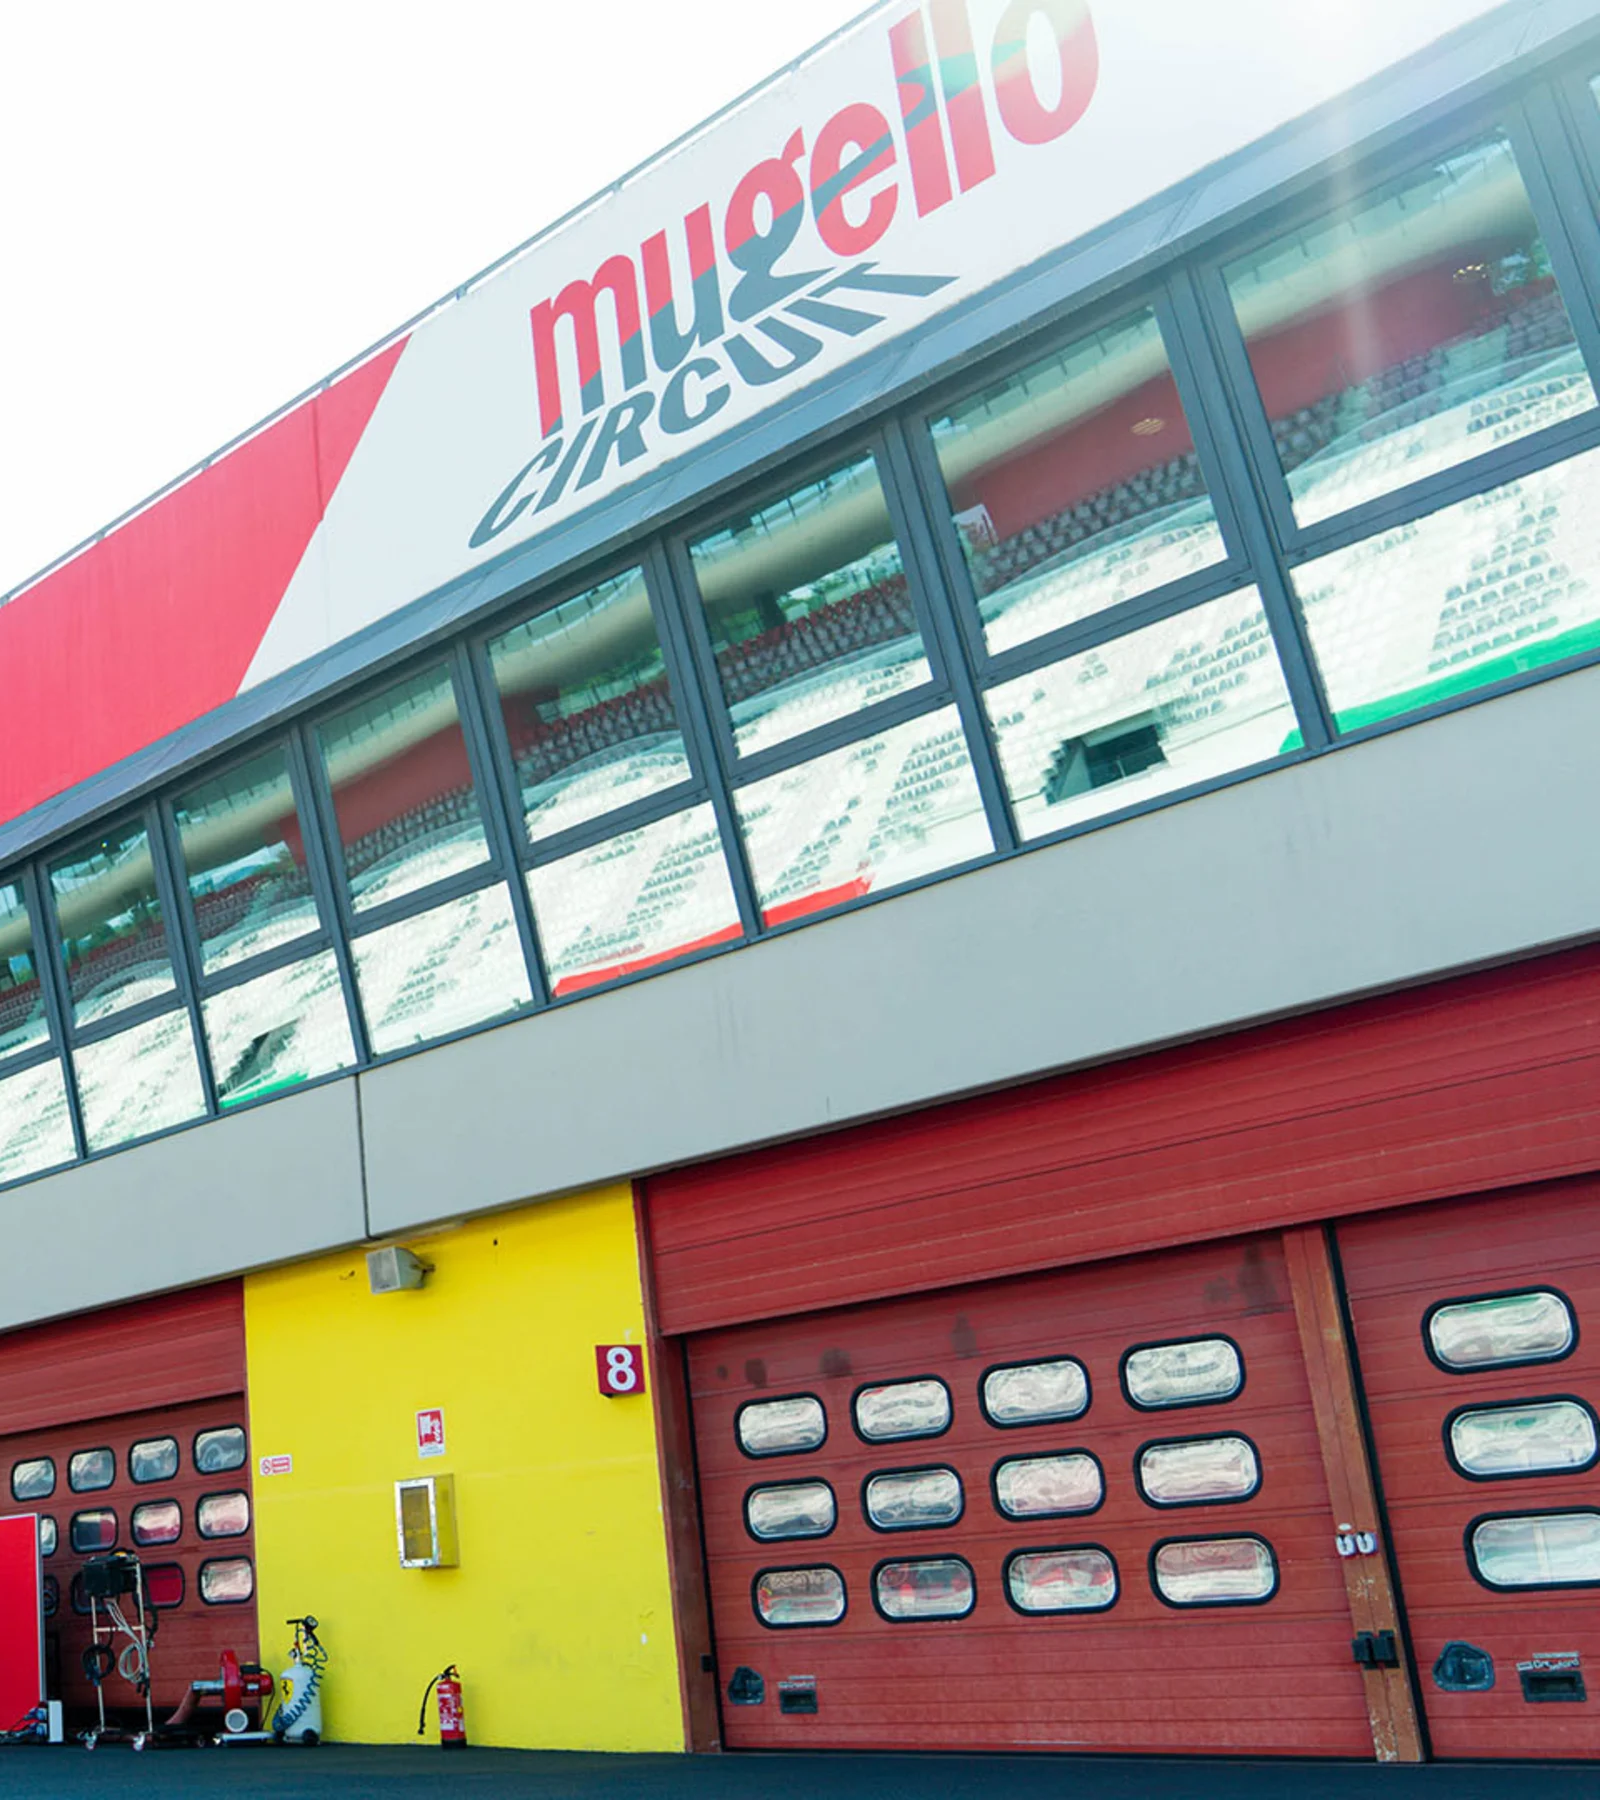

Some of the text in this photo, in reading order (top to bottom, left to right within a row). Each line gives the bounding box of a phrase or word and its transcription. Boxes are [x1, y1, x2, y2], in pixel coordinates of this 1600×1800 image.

[530, 0, 1099, 440] mugello
[468, 262, 960, 549] CIRCUIT
[606, 1346, 636, 1391] 8
